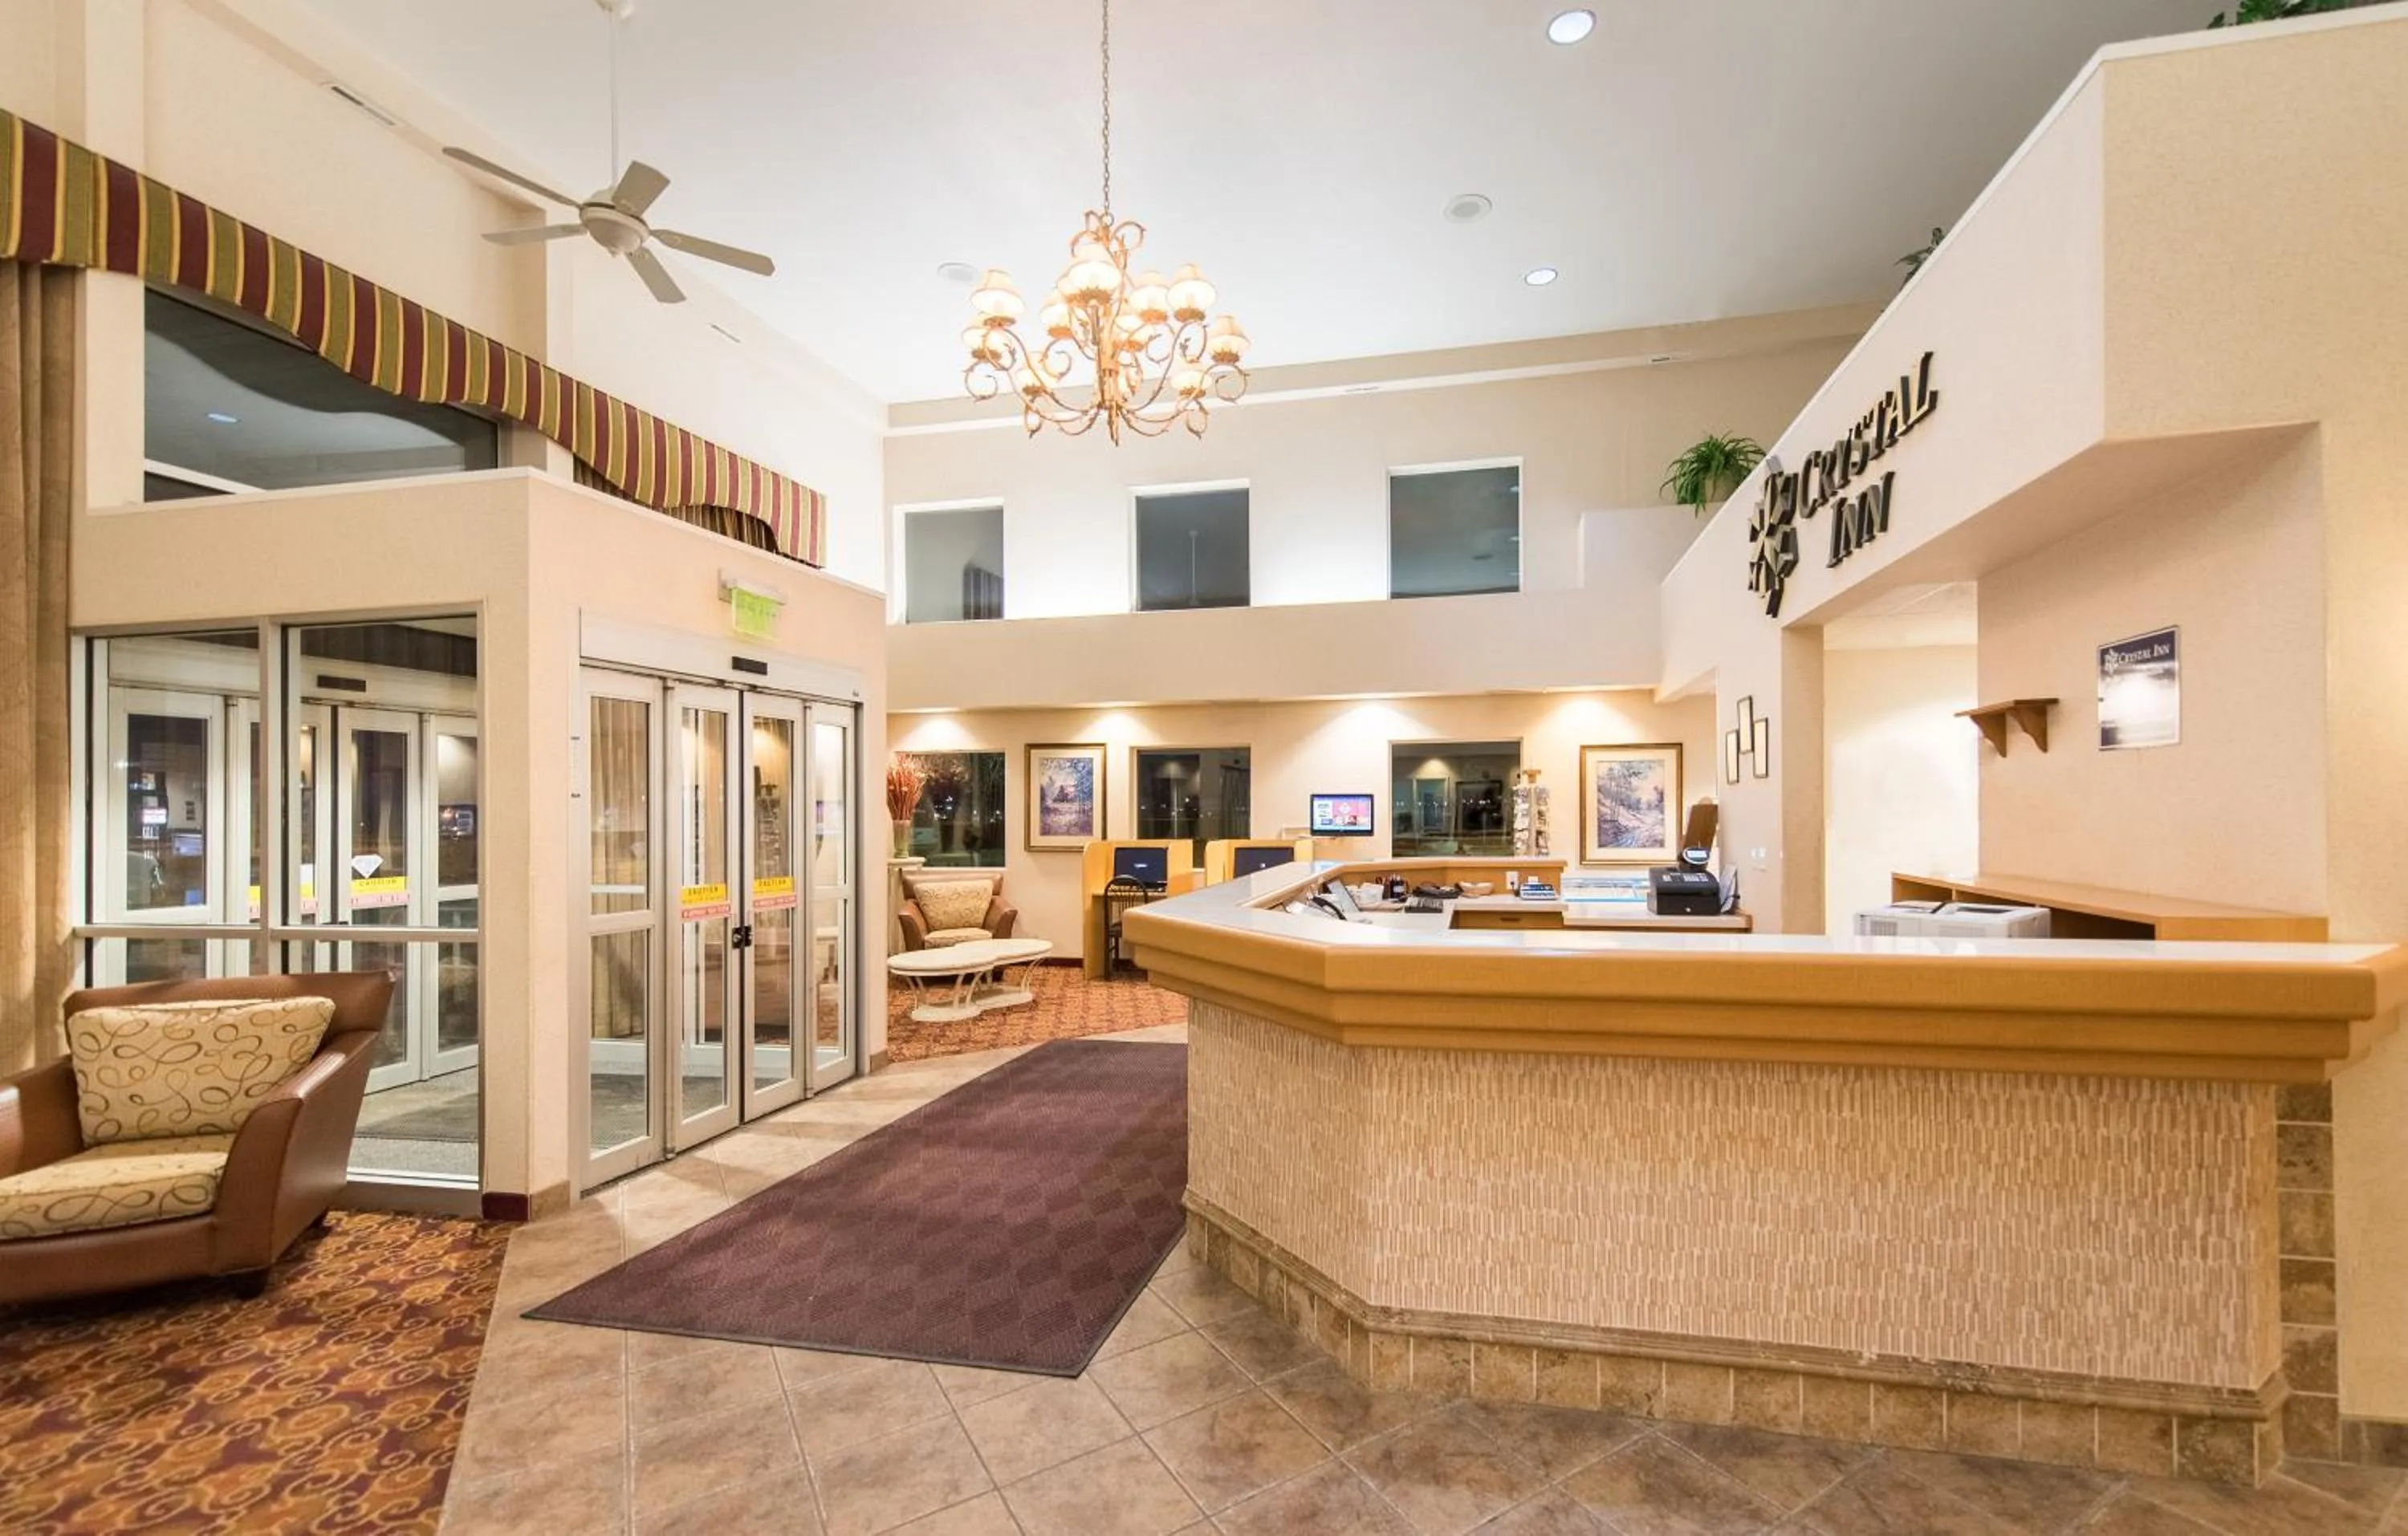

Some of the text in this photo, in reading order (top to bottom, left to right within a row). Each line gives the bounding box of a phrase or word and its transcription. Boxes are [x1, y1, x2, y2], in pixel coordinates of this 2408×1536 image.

[1798, 351, 1938, 518] CRYSTAL
[1827, 471, 1896, 568] INN
[2119, 644, 2170, 664] CRYSTAL INN
